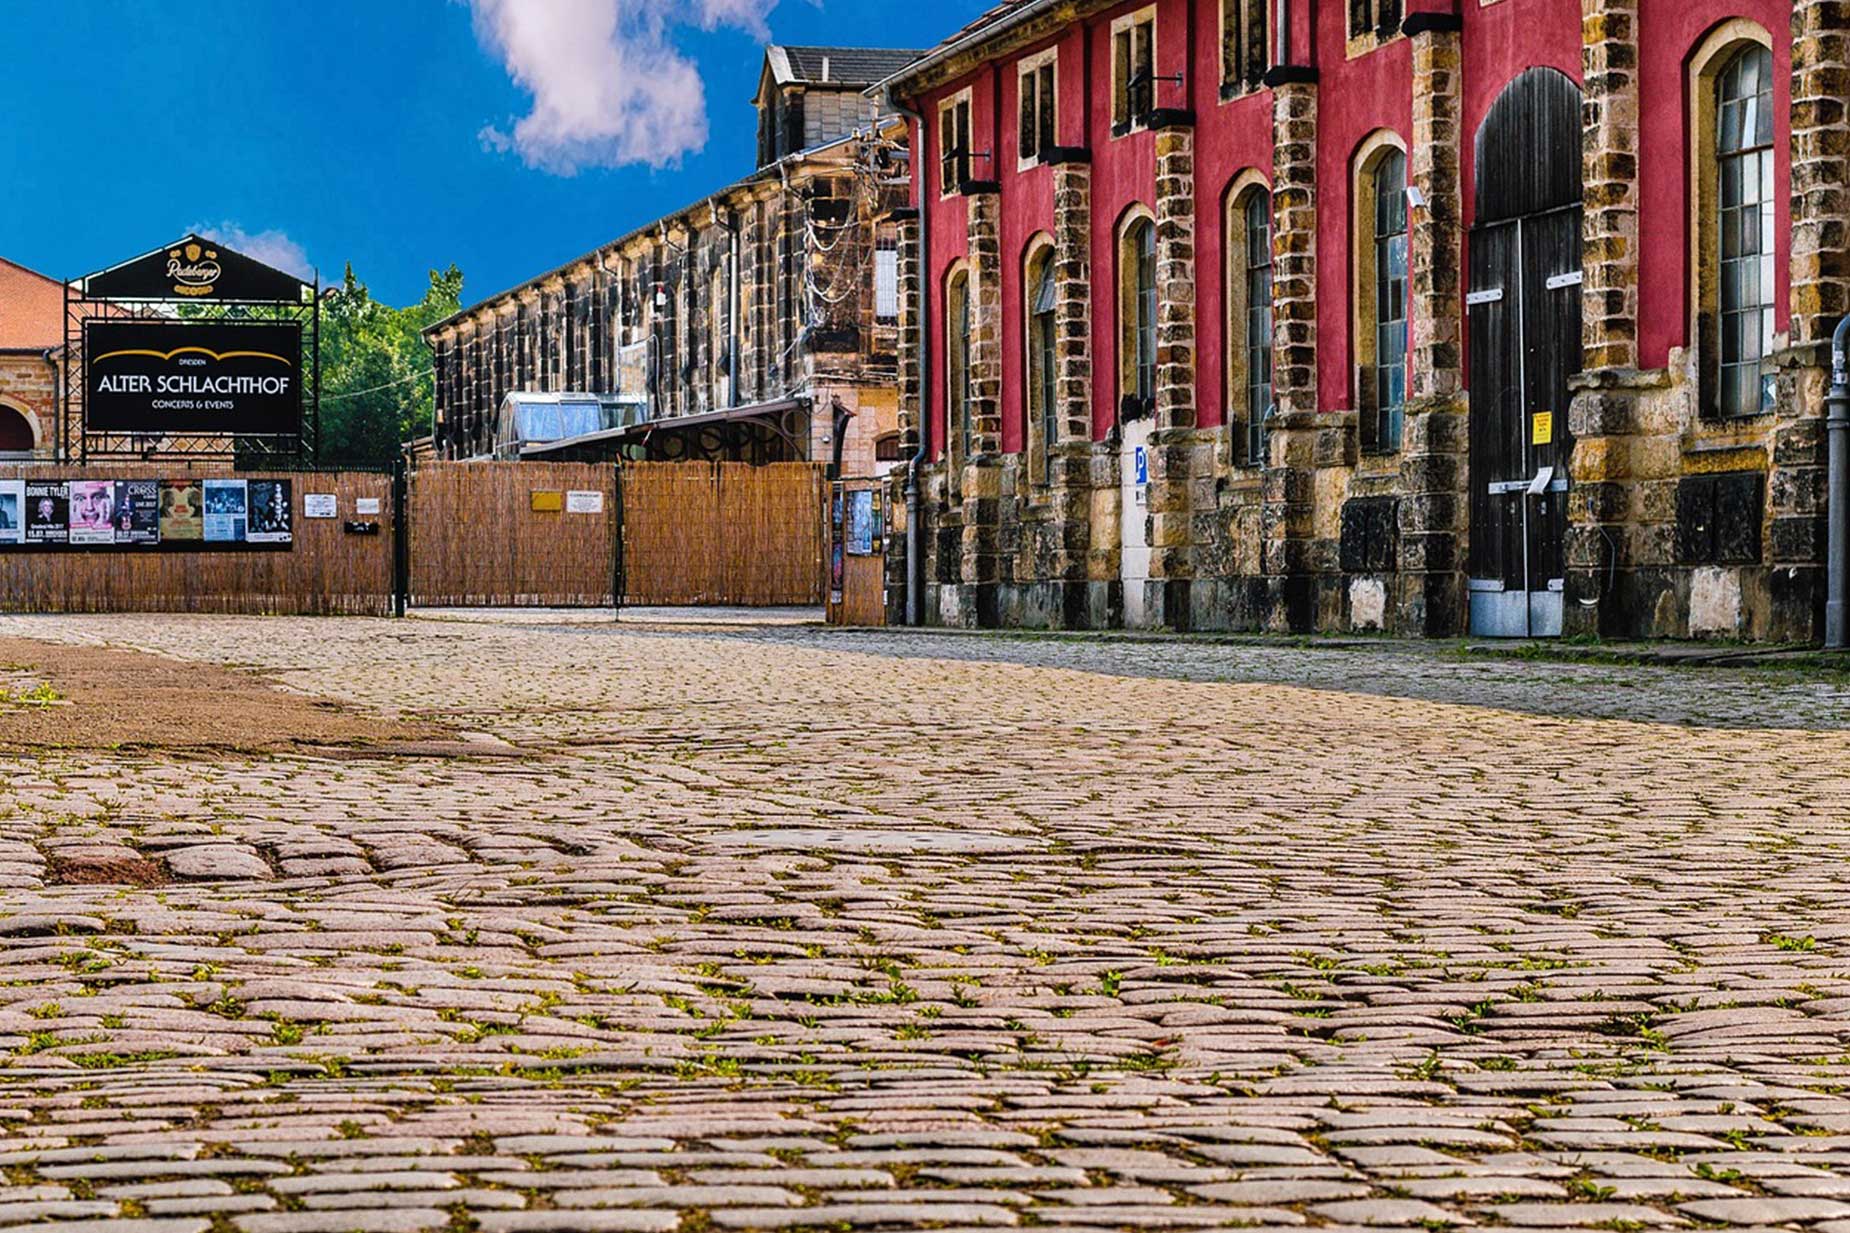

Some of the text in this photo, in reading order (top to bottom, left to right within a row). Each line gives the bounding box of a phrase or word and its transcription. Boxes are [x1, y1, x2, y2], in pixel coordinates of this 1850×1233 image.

[166, 258, 221, 282] Radeberger
[178, 358, 207, 366] DRESDEN
[97, 375, 290, 395] ALTER SCHLACHTHOF
[152, 399, 234, 410] CONCERTS & EVENTS
[26, 486, 69, 497] BONNIE TYLER
[127, 484, 157, 496] CROSS
